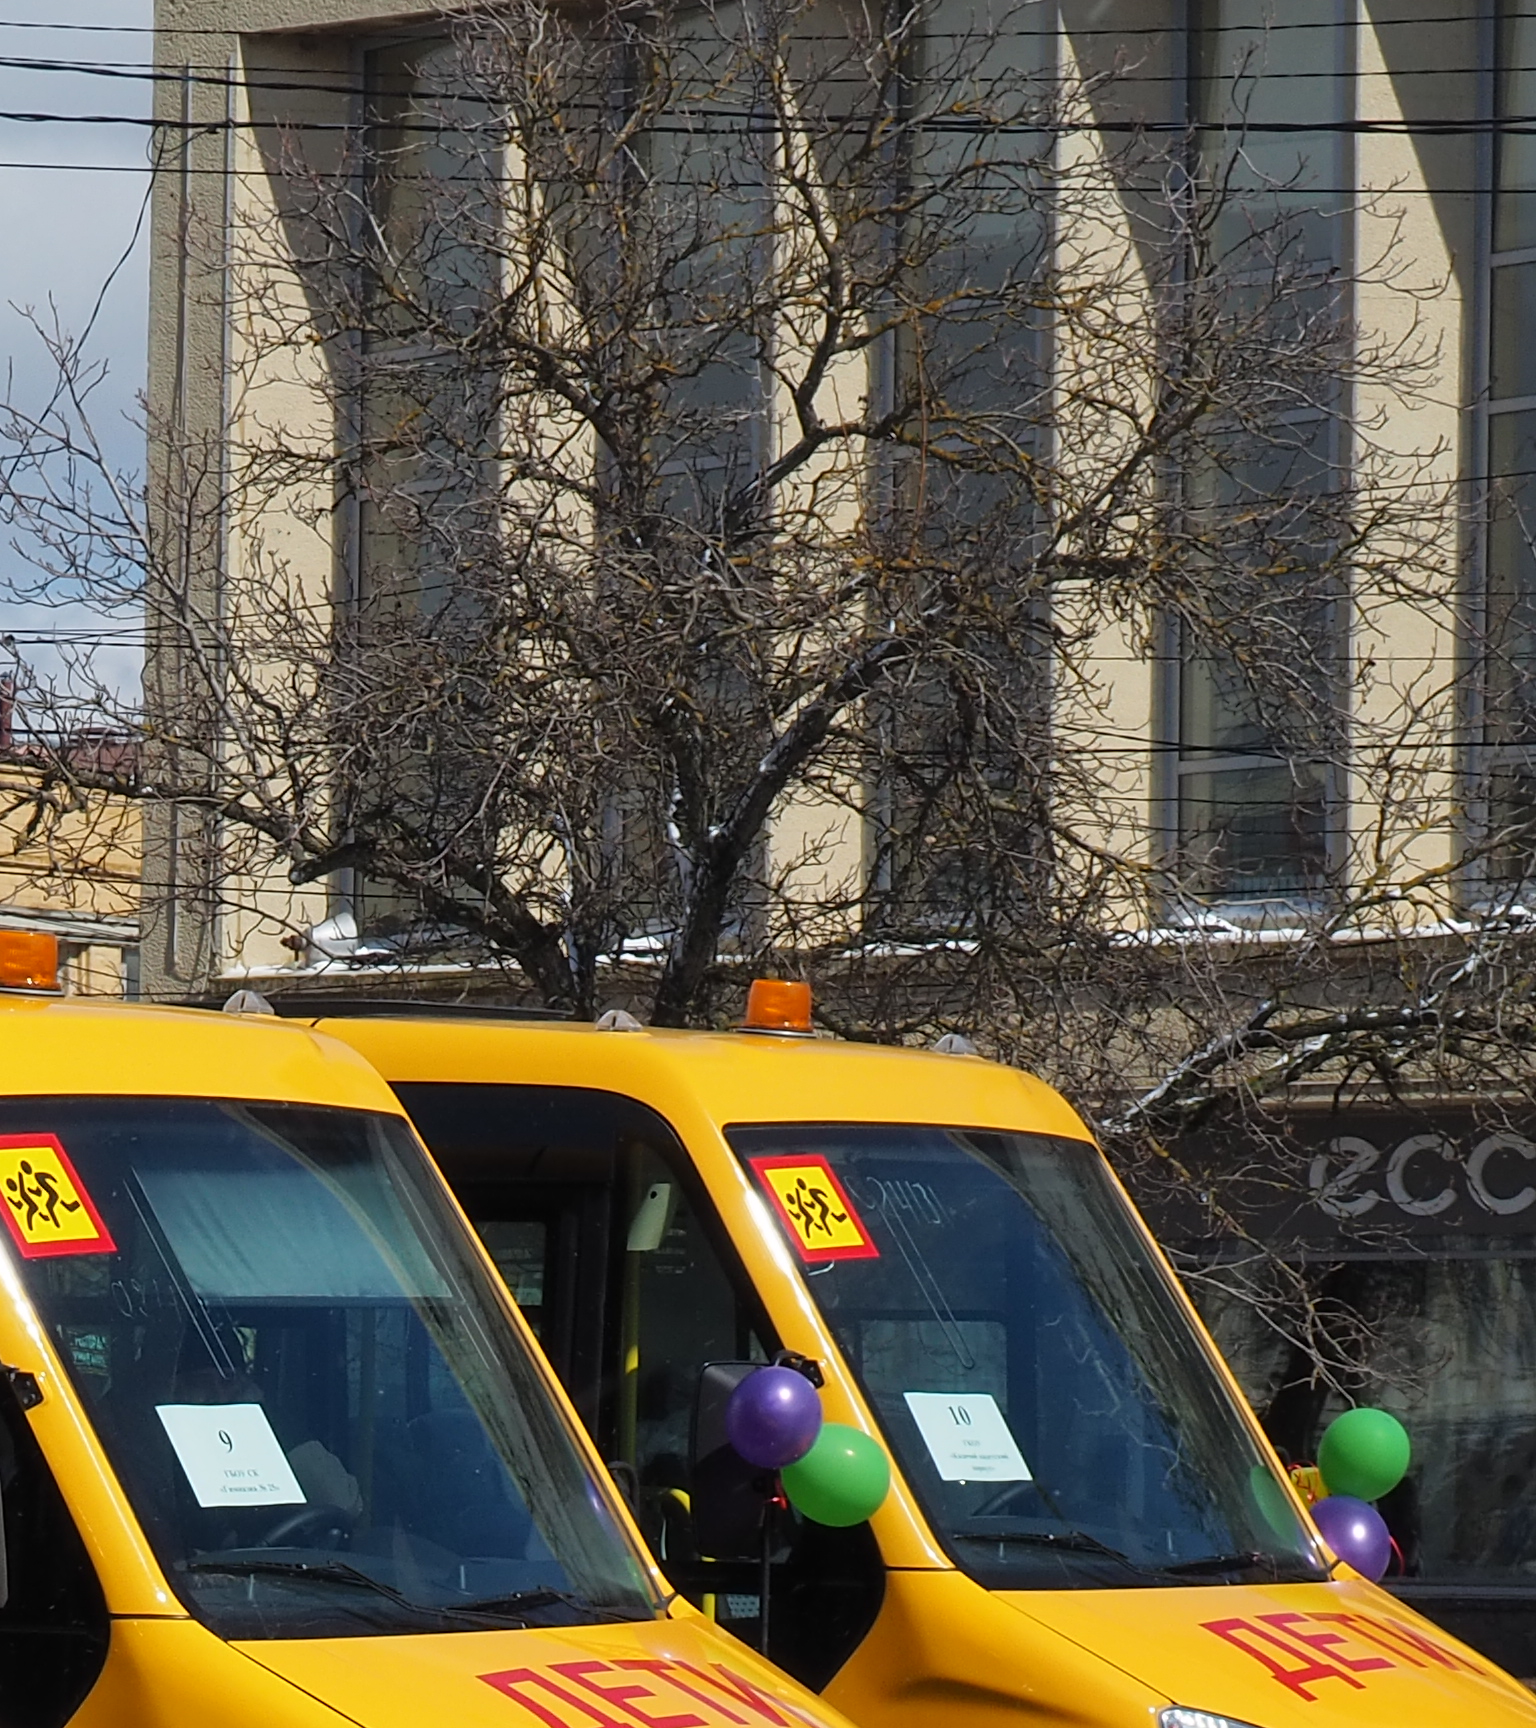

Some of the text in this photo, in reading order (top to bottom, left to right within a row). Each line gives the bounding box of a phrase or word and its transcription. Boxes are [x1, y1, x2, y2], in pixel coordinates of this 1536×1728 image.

[948, 1405, 972, 1426] 10
[218, 1429, 234, 1454] 9
[1197, 1612, 1488, 1702] ДЕТИ
